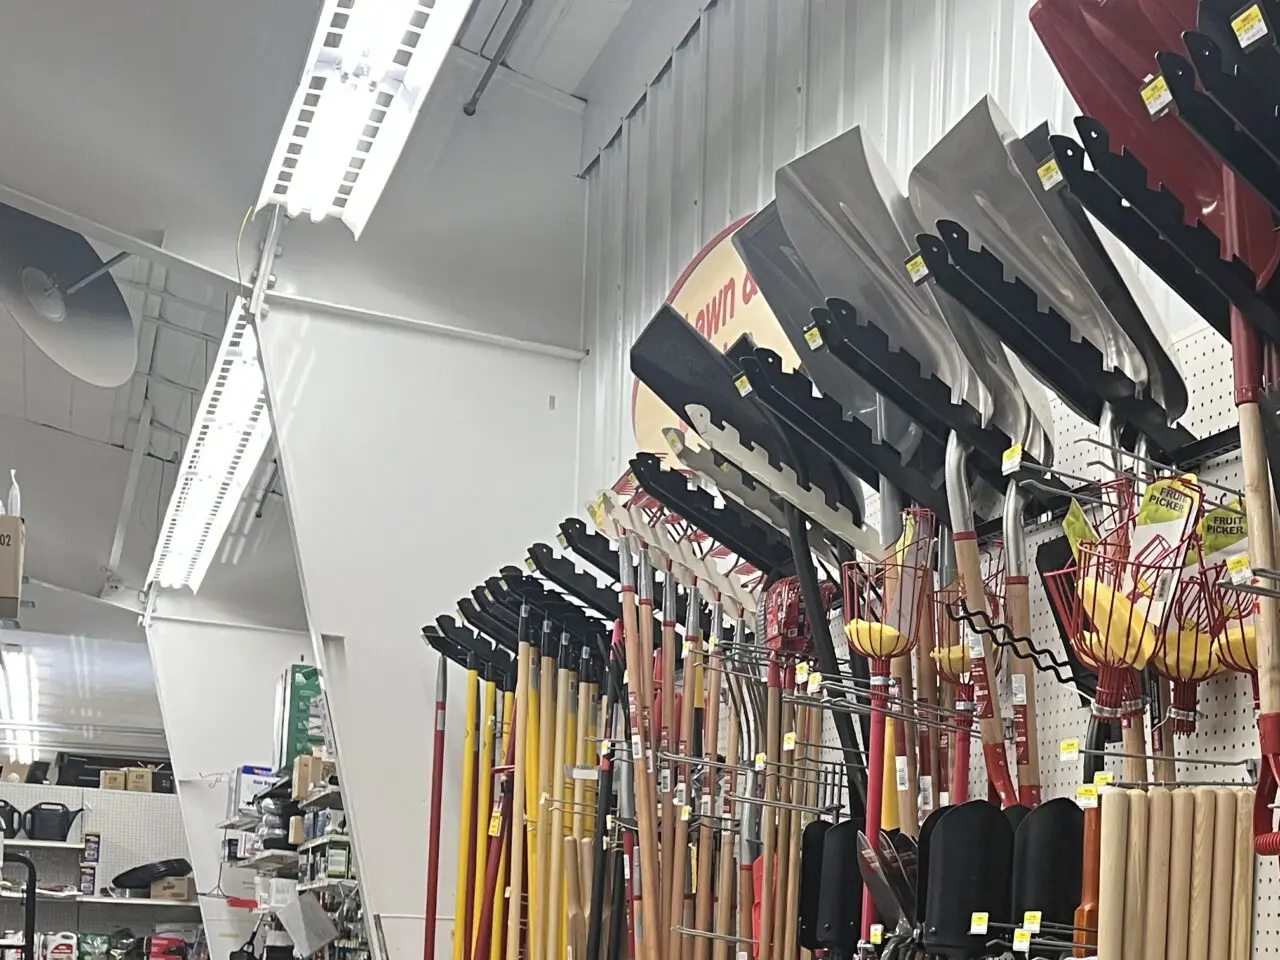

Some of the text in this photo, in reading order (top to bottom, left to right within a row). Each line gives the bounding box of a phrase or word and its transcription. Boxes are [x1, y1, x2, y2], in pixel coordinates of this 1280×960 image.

[1149, 495, 1184, 513] PICKER
[1213, 516, 1243, 527] FRUIT
[1206, 525, 1244, 535] PICKER
